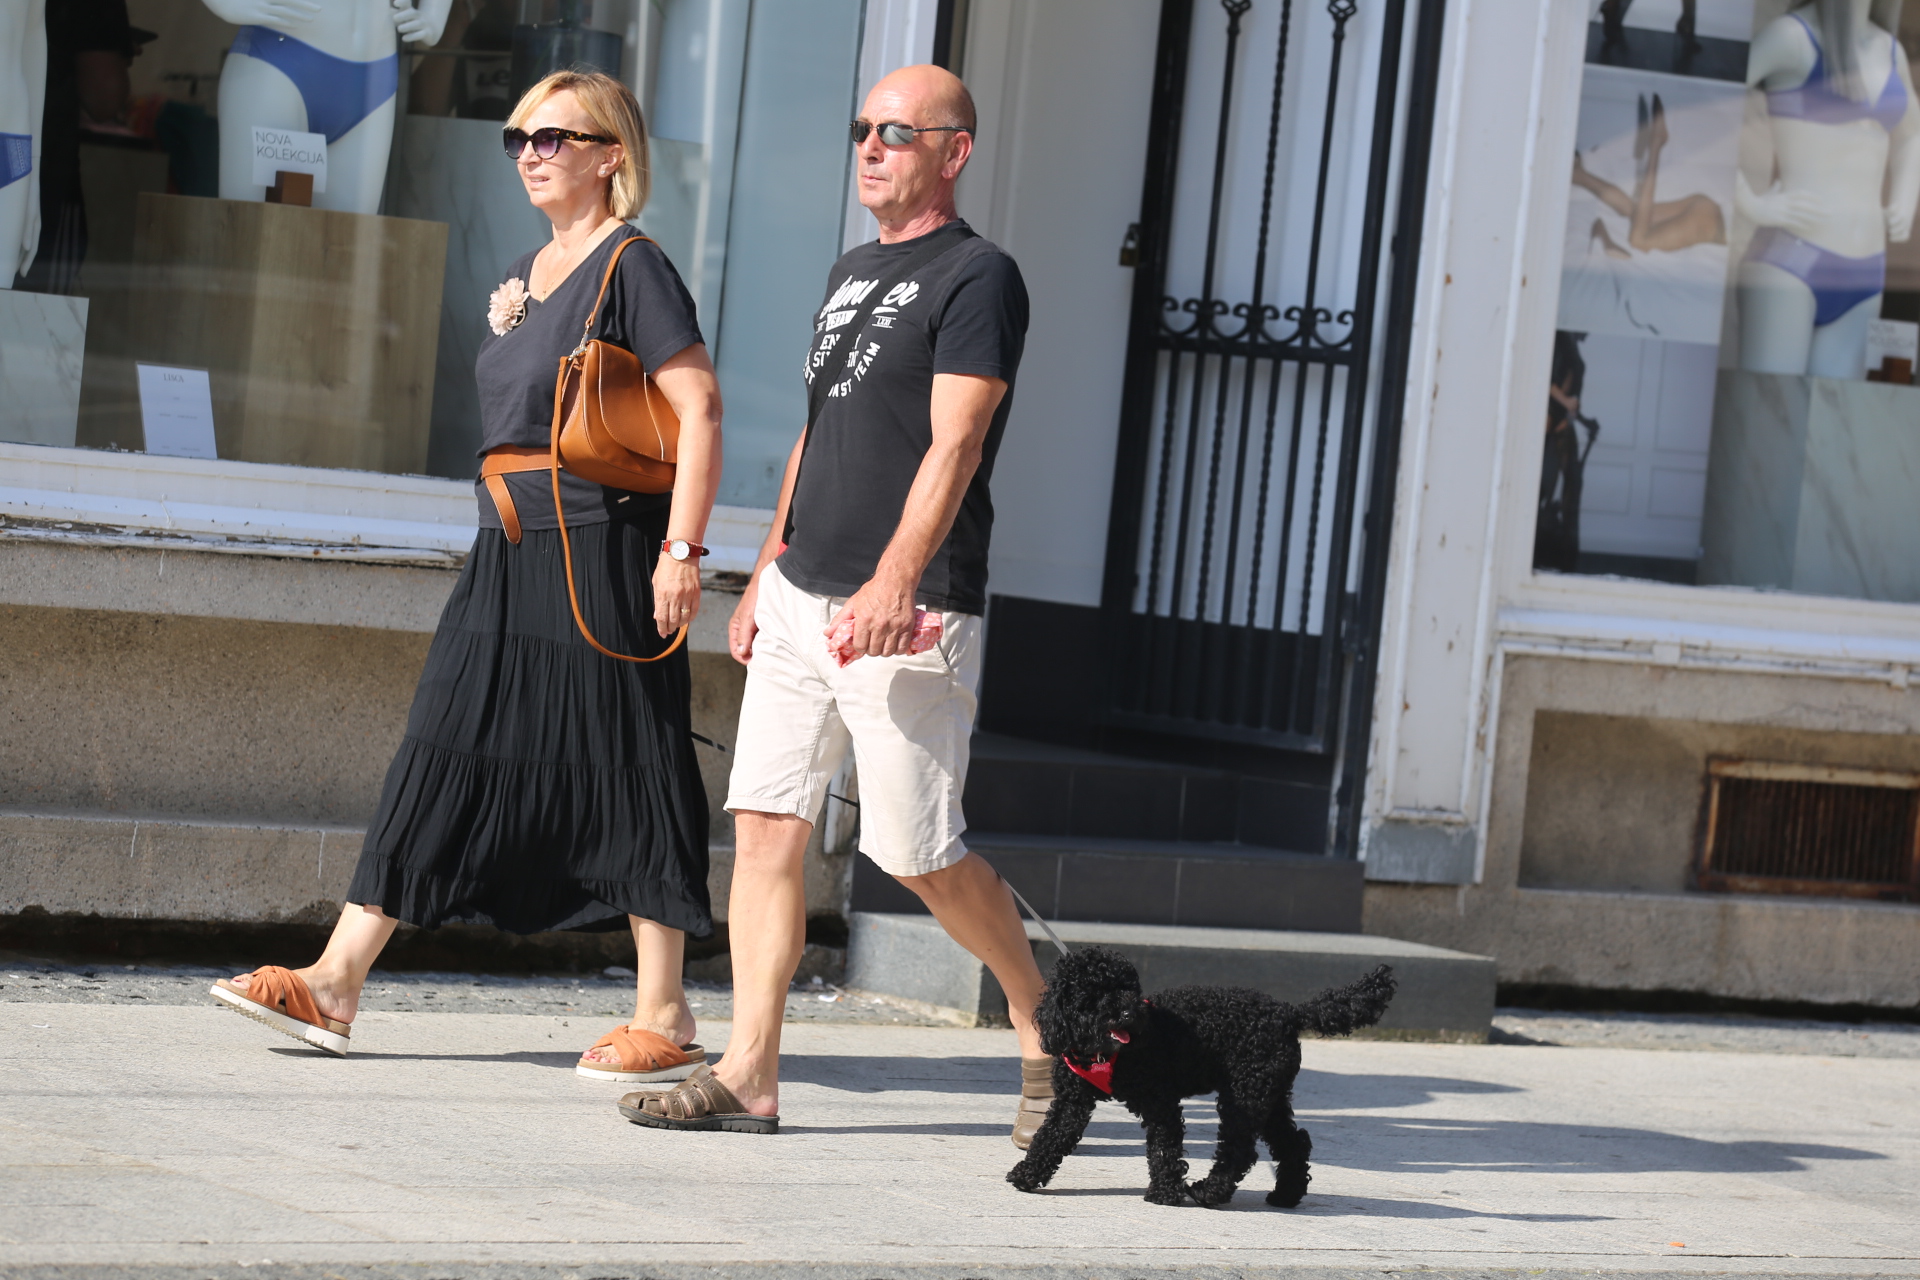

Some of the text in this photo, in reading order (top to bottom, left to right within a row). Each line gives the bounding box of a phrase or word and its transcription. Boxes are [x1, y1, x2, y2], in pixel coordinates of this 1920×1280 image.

[255, 131, 292, 146] NOVA
[256, 145, 325, 165] KOLEKCIJA
[854, 341, 881, 382] TEAM
